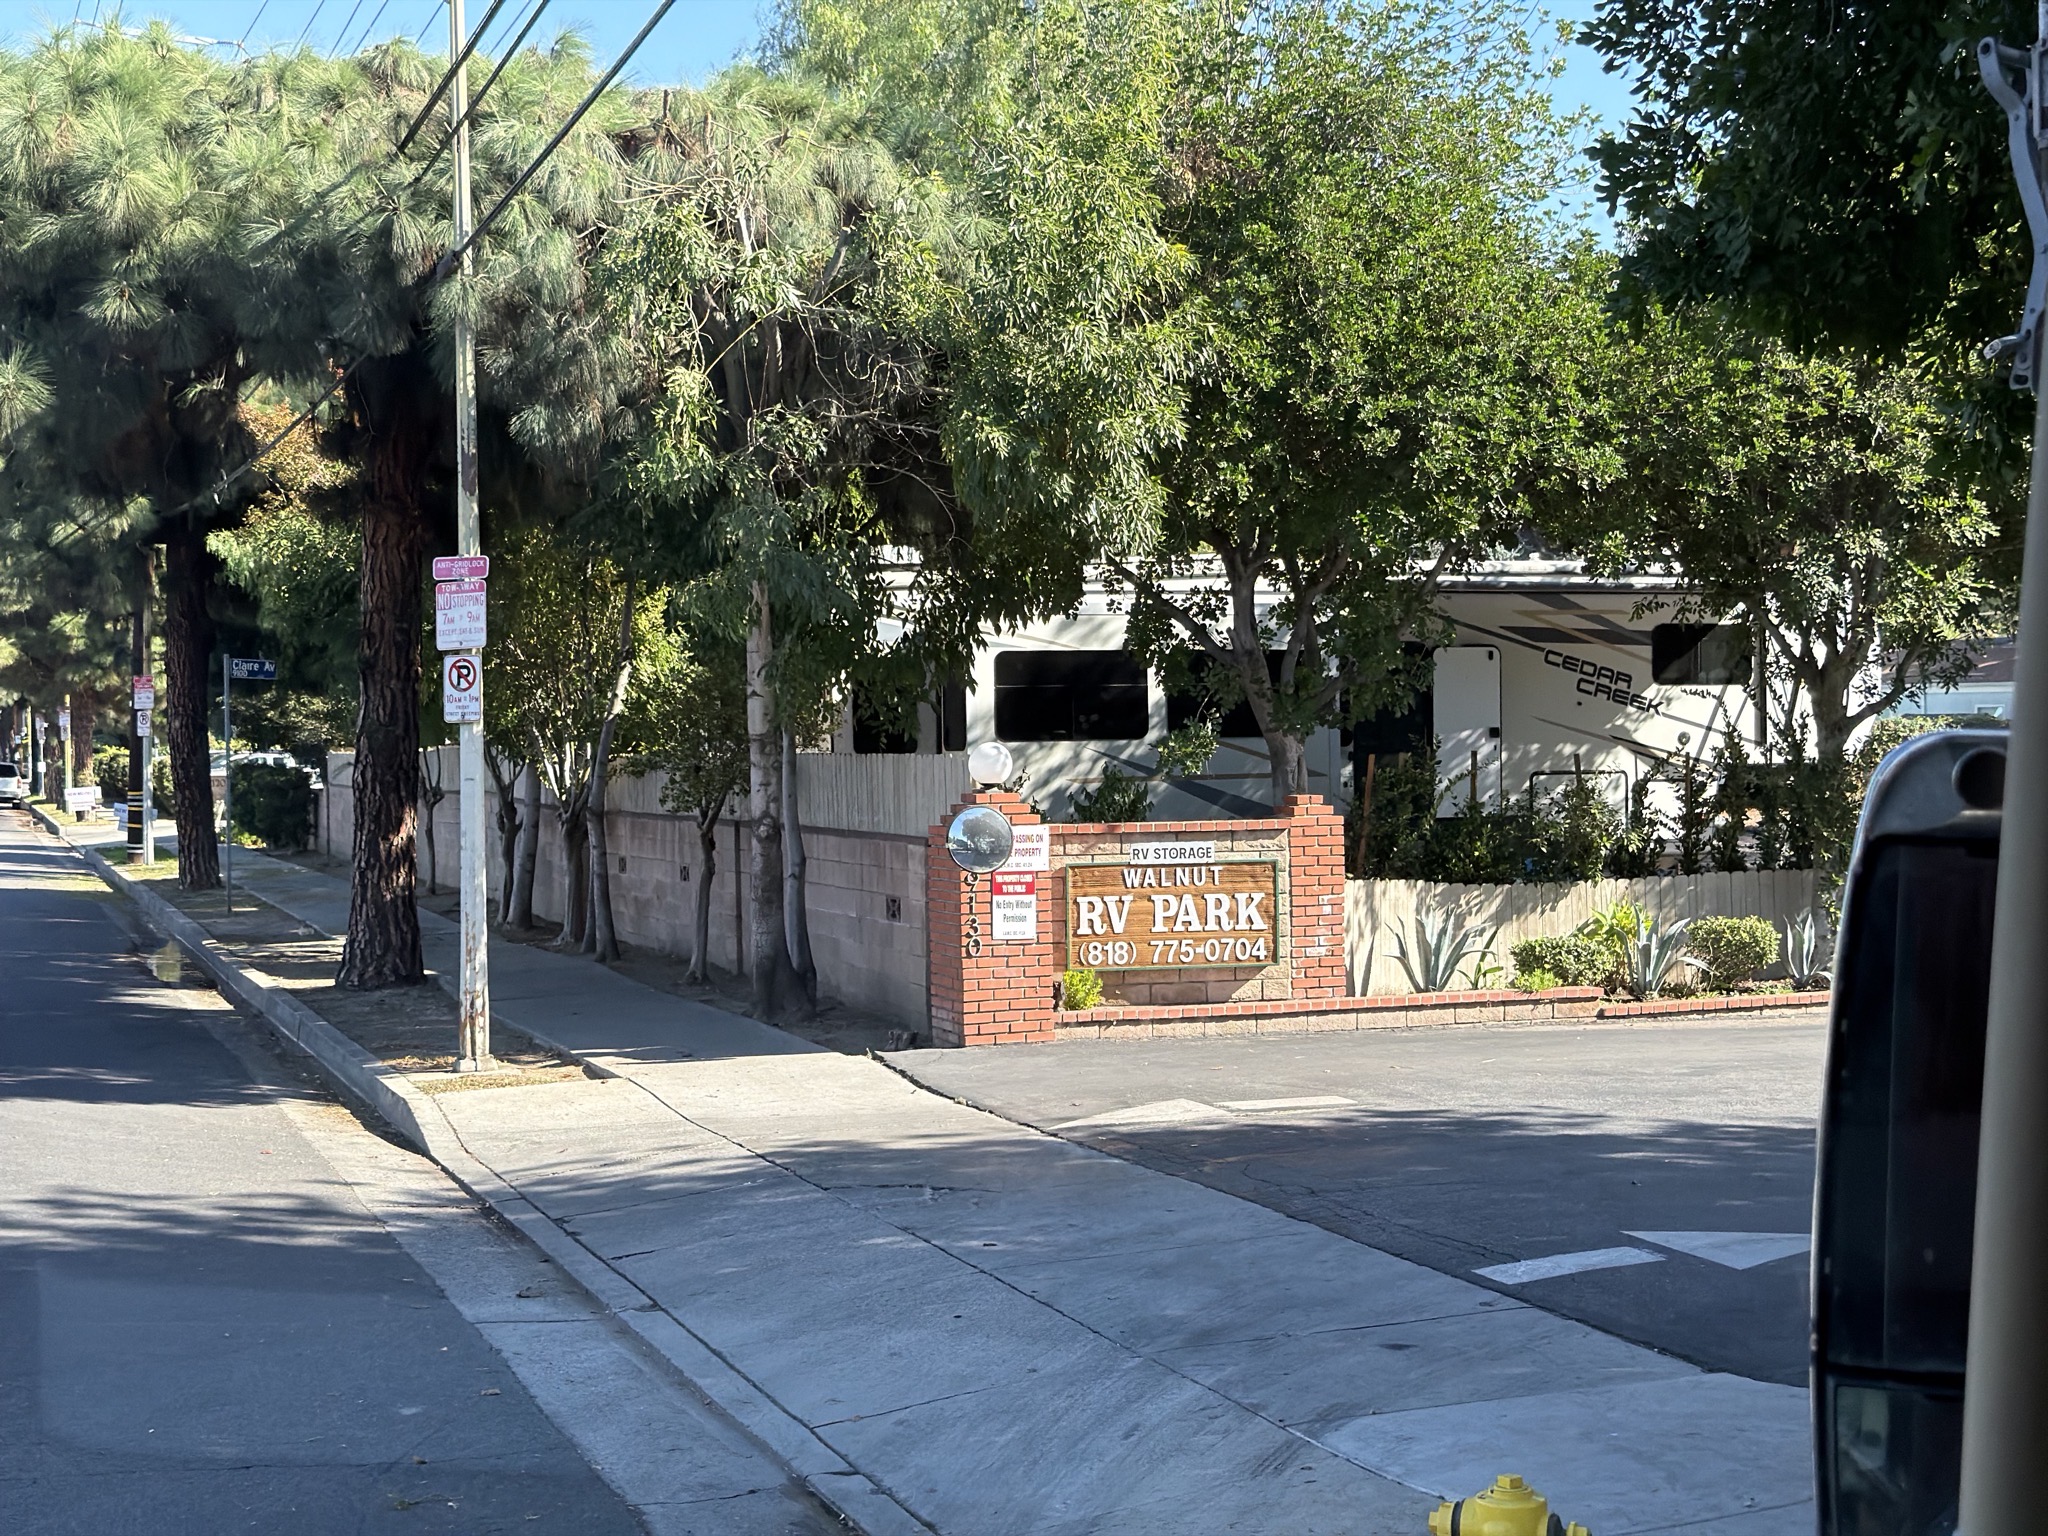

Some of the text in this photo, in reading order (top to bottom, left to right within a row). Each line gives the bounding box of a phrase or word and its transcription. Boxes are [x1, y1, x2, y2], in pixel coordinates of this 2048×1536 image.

[436, 560, 485, 568] ANTI-GRIDLOCK
[452, 567, 470, 575] ZONE
[438, 593, 484, 610] NO STOPPING
[442, 613, 455, 625] 7AM
[467, 611, 481, 622] 9AM
[232, 659, 276, 672] Claire Av
[1544, 649, 1633, 689] CEDAR
[446, 694, 462, 704] 10AM
[1576, 677, 1664, 715] CREEK
[1012, 833, 1044, 844] PASSING ON
[1014, 847, 1042, 858] PROPERTY
[1132, 846, 1212, 861] RV STORAGE
[1123, 866, 1223, 889] WALNUT
[995, 899, 1033, 911] No Entry Without
[1002, 913, 1027, 923] Permission
[1076, 892, 1269, 936] RV PARK
[1079, 937, 1268, 967] (818) 775-0704
